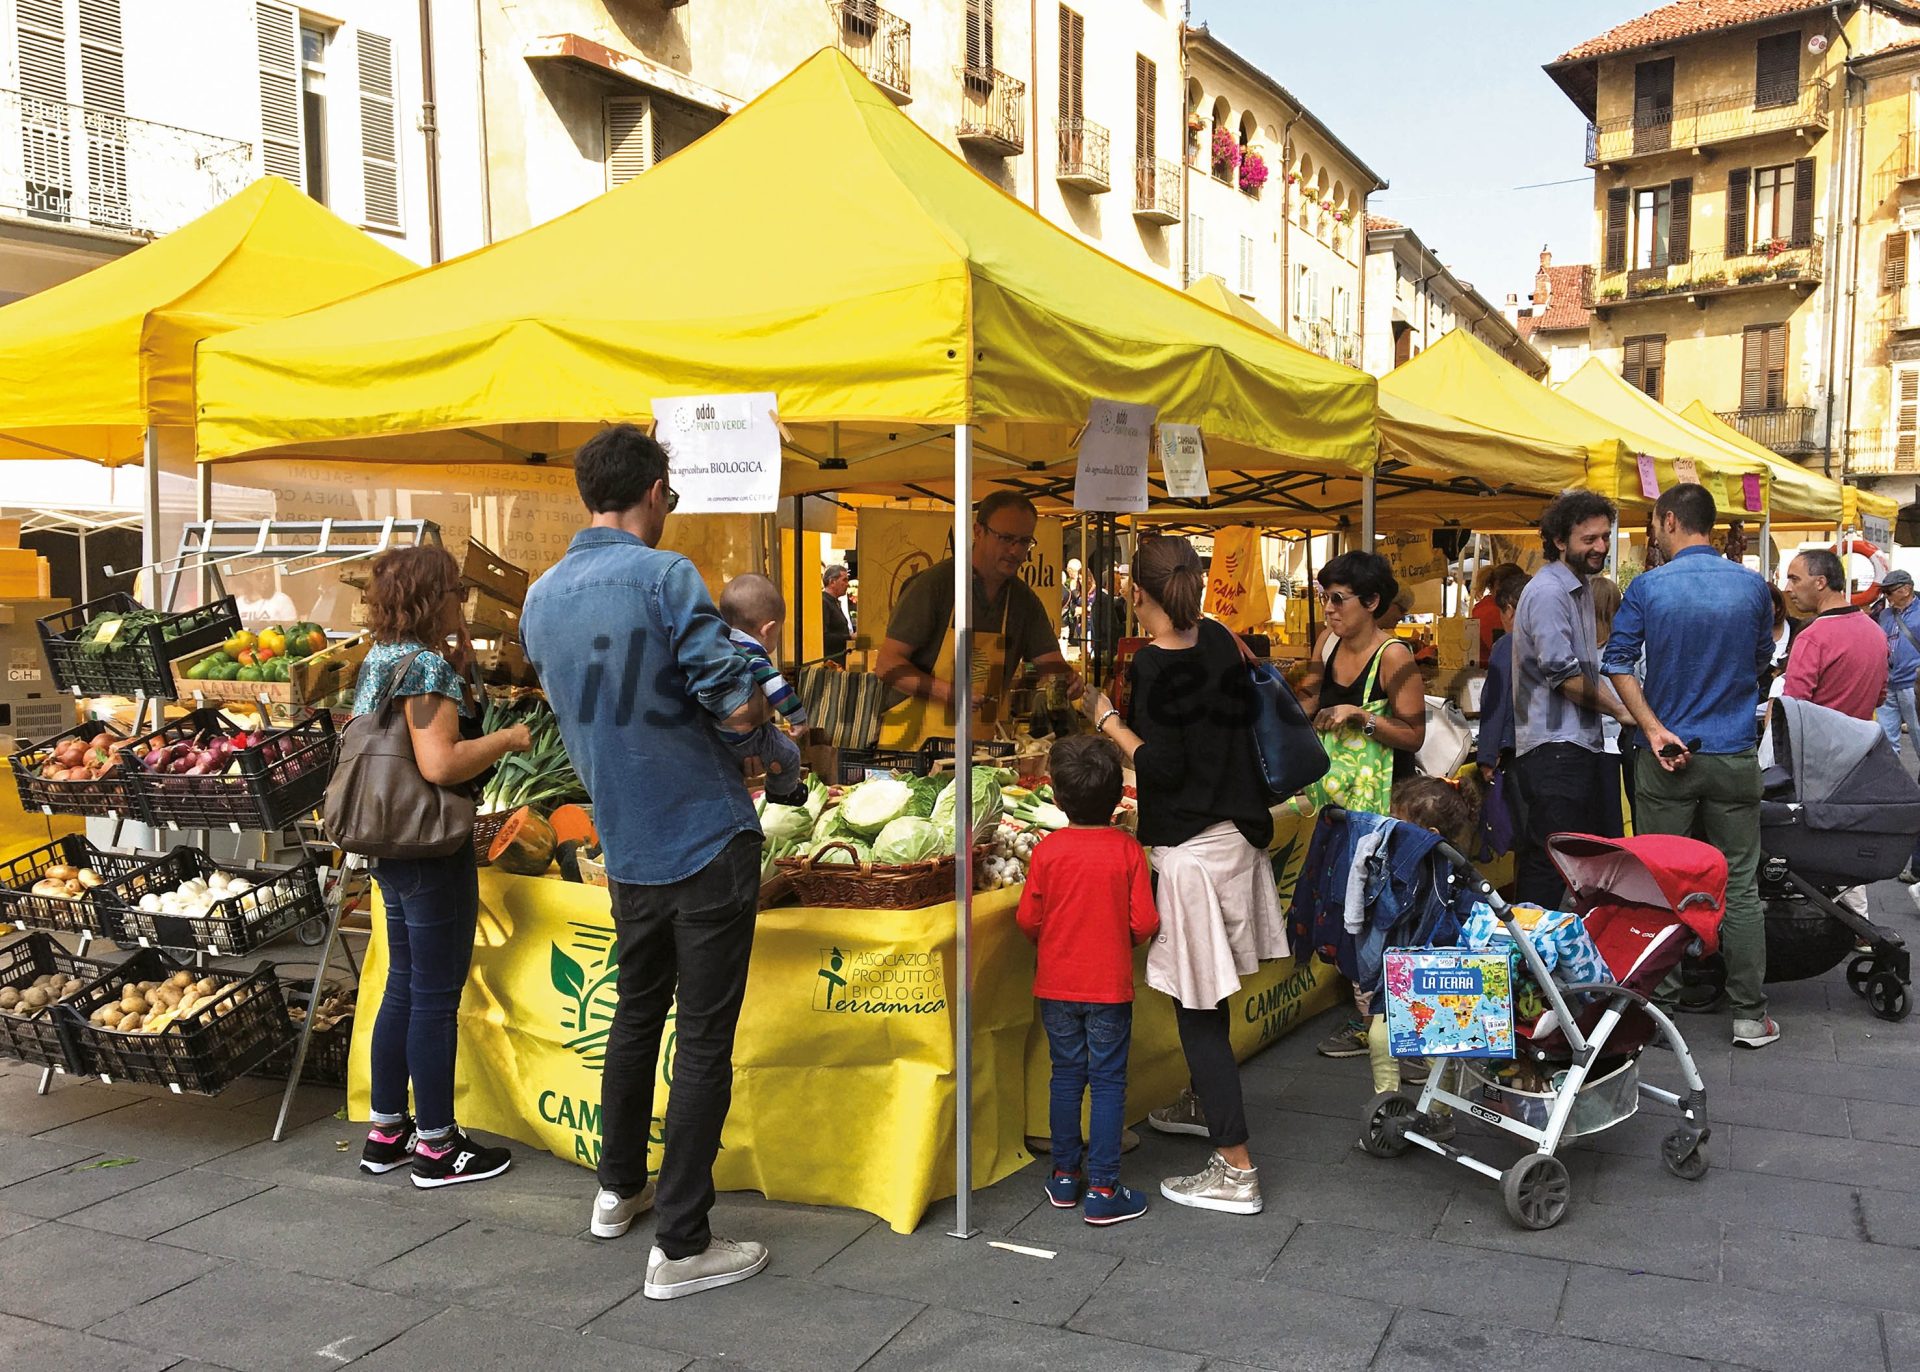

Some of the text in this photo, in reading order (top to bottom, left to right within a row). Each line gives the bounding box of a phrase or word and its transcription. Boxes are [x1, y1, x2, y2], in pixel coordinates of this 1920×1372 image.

[696, 403, 716, 421] oddo
[696, 419, 747, 432] PUNTO VERDE
[678, 464, 709, 478] agricoltura
[1422, 976, 1474, 989] LA TERRA
[1245, 965, 1317, 1023] CAMPAGNA
[1260, 1000, 1302, 1041] AMICA
[1472, 1106, 1500, 1122] be cool
